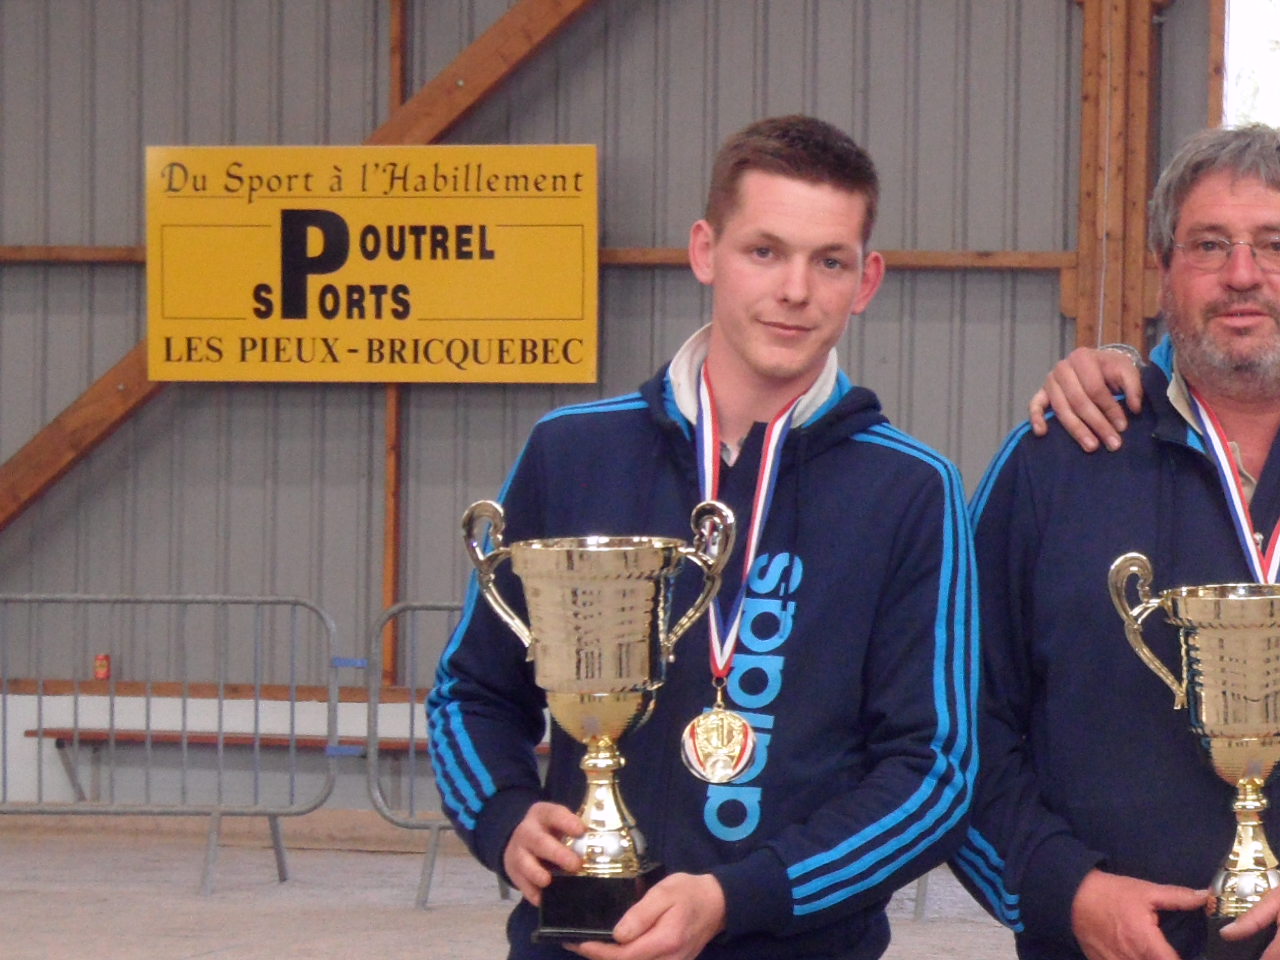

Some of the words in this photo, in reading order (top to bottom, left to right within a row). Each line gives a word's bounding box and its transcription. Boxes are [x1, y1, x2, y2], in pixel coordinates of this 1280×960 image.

[160, 161, 208, 195] Du
[223, 162, 313, 204] Sport
[329, 165, 344, 193] à
[361, 162, 585, 197] l'Habillement
[163, 336, 224, 364] LES
